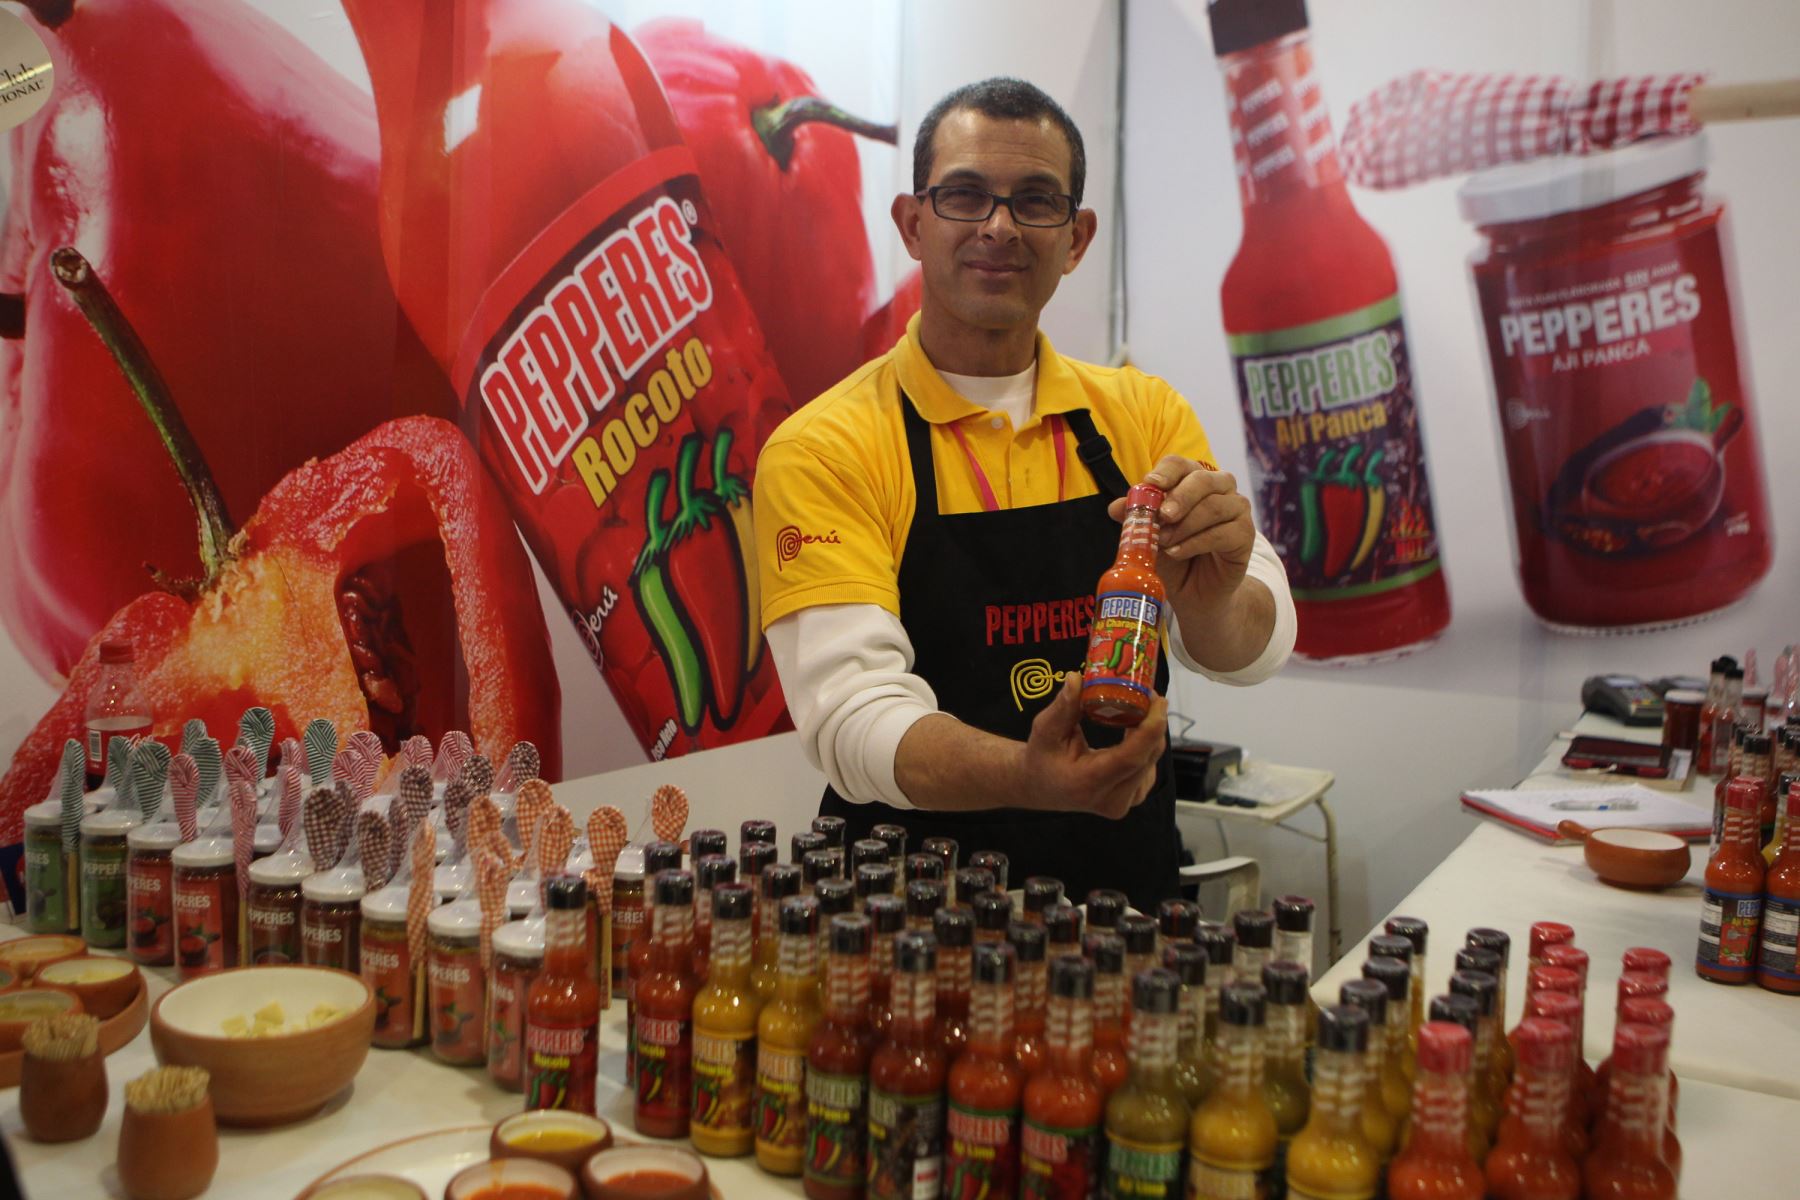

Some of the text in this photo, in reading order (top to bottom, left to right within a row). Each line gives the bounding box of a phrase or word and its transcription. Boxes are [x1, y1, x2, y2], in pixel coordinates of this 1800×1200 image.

[0, 80, 43, 103] IONAL
[480, 196, 712, 495] PEPPERES
[1500, 273, 1700, 357] PEPPERES
[1244, 330, 1396, 419] PEPPERES
[1583, 339, 1650, 367] PANCA
[1310, 402, 1388, 442] Panca
